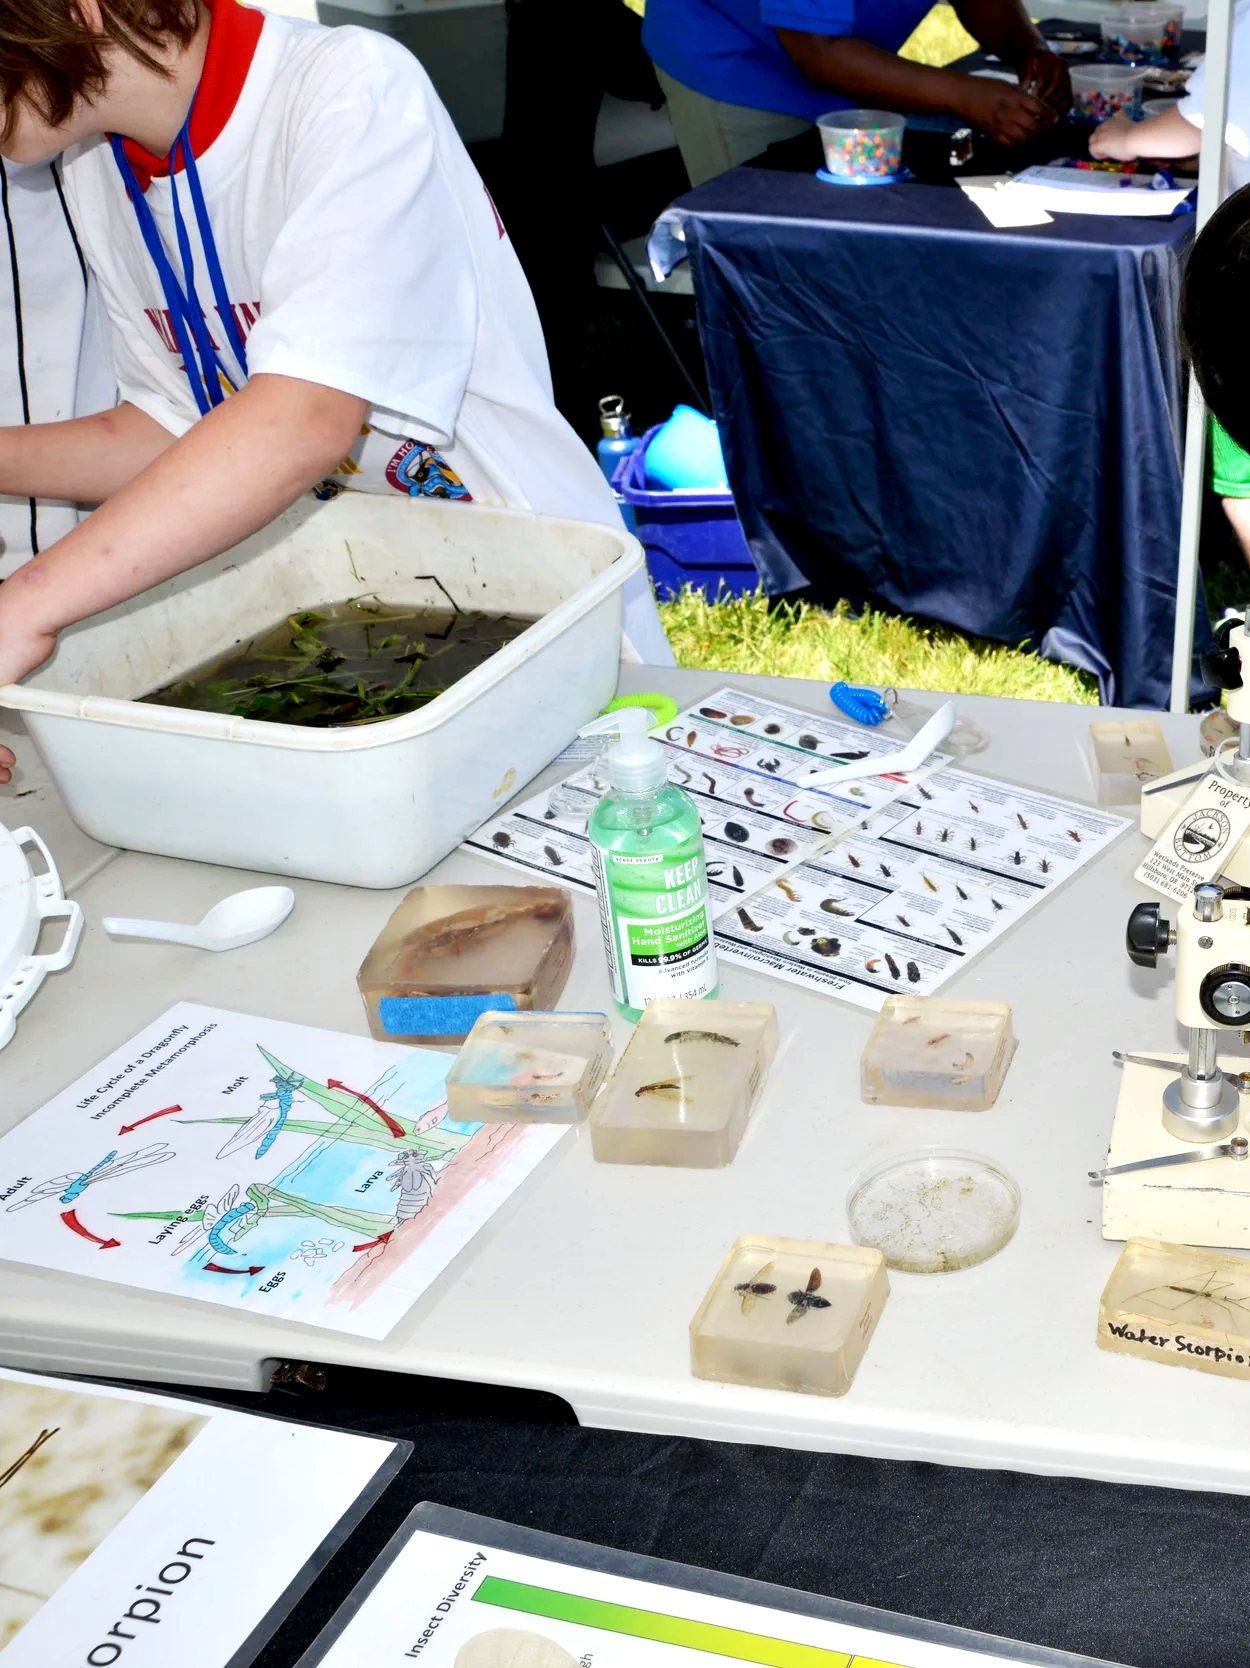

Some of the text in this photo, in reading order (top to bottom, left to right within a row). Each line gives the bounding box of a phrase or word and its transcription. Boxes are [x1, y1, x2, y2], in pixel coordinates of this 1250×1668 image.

[1219, 800, 1231, 808] of
[1192, 809, 1230, 835] JACKSON
[1174, 837, 1212, 861] BOTTOM
[664, 856, 698, 890] KEEP
[1142, 862, 1168, 880] Hillsboro,
[1170, 876, 1179, 885] OR
[1144, 872, 1159, 883] (503)
[1154, 851, 1205, 881] Wetlands Preserve
[1162, 864, 1175, 874] West
[1176, 872, 1190, 883] Main
[655, 881, 702, 914] CLEAN
[632, 919, 705, 945] Hand Sanitizer
[643, 911, 704, 936] Moisturizing
[657, 952, 682, 964] 99.9%
[682, 948, 692, 957] OF
[676, 939, 693, 948] with
[671, 970, 685, 978] with
[785, 967, 846, 990] Freshwater
[76, 1094, 99, 1109] Life
[96, 1073, 125, 1094] Cycle
[124, 1064, 136, 1074] of
[141, 1024, 189, 1058] Dragonfly
[90, 1022, 218, 1120] Incomplete Metamorphosis
[221, 1075, 249, 1096] Molt
[0, 1176, 32, 1201] Adult
[354, 1170, 384, 1193] Larva
[148, 1194, 209, 1245] Laying eggs
[258, 1271, 286, 1293] Eggs
[1108, 1322, 1170, 1348] Water
[87, 1537, 216, 1668] orpion
[404, 1551, 488, 1658] Insect Diversity
